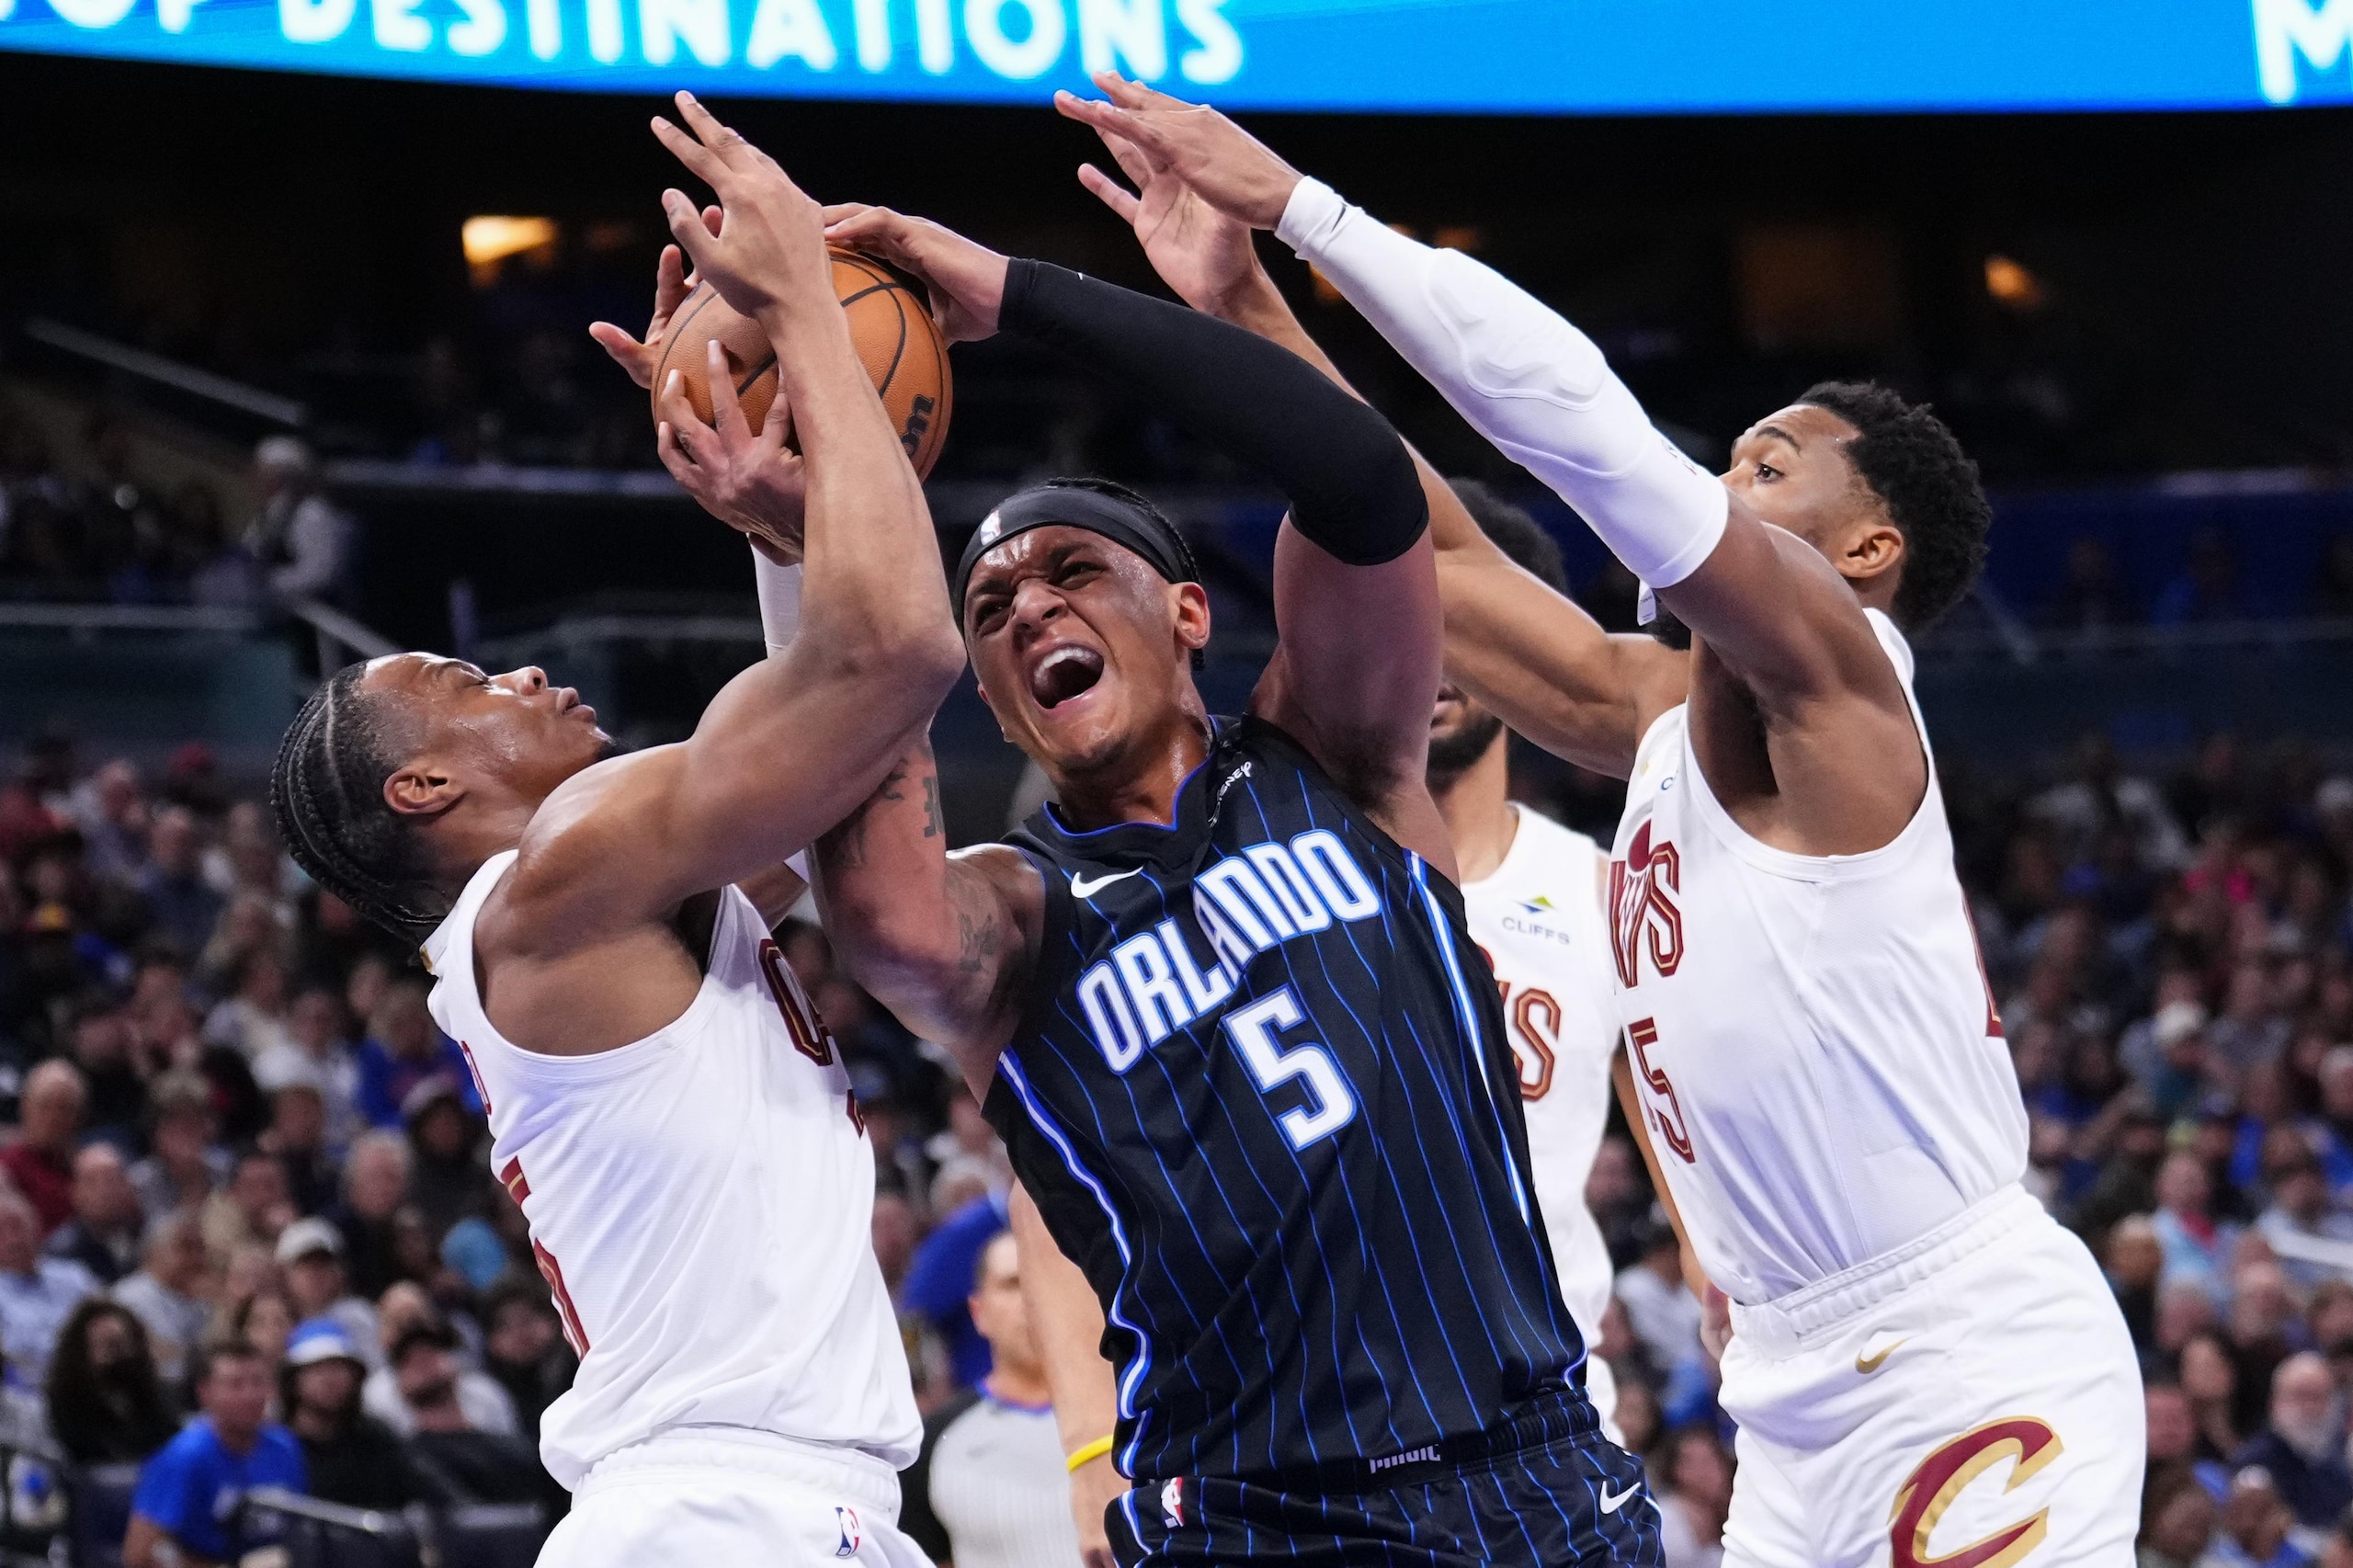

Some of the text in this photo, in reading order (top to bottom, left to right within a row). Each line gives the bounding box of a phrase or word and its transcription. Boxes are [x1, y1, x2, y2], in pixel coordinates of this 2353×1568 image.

[1076, 828, 1382, 1075] ORLANDO
[1502, 916, 1570, 946] CLIFFS
[1222, 984, 1358, 1152] 5
[1628, 1017, 1696, 1164] 5
